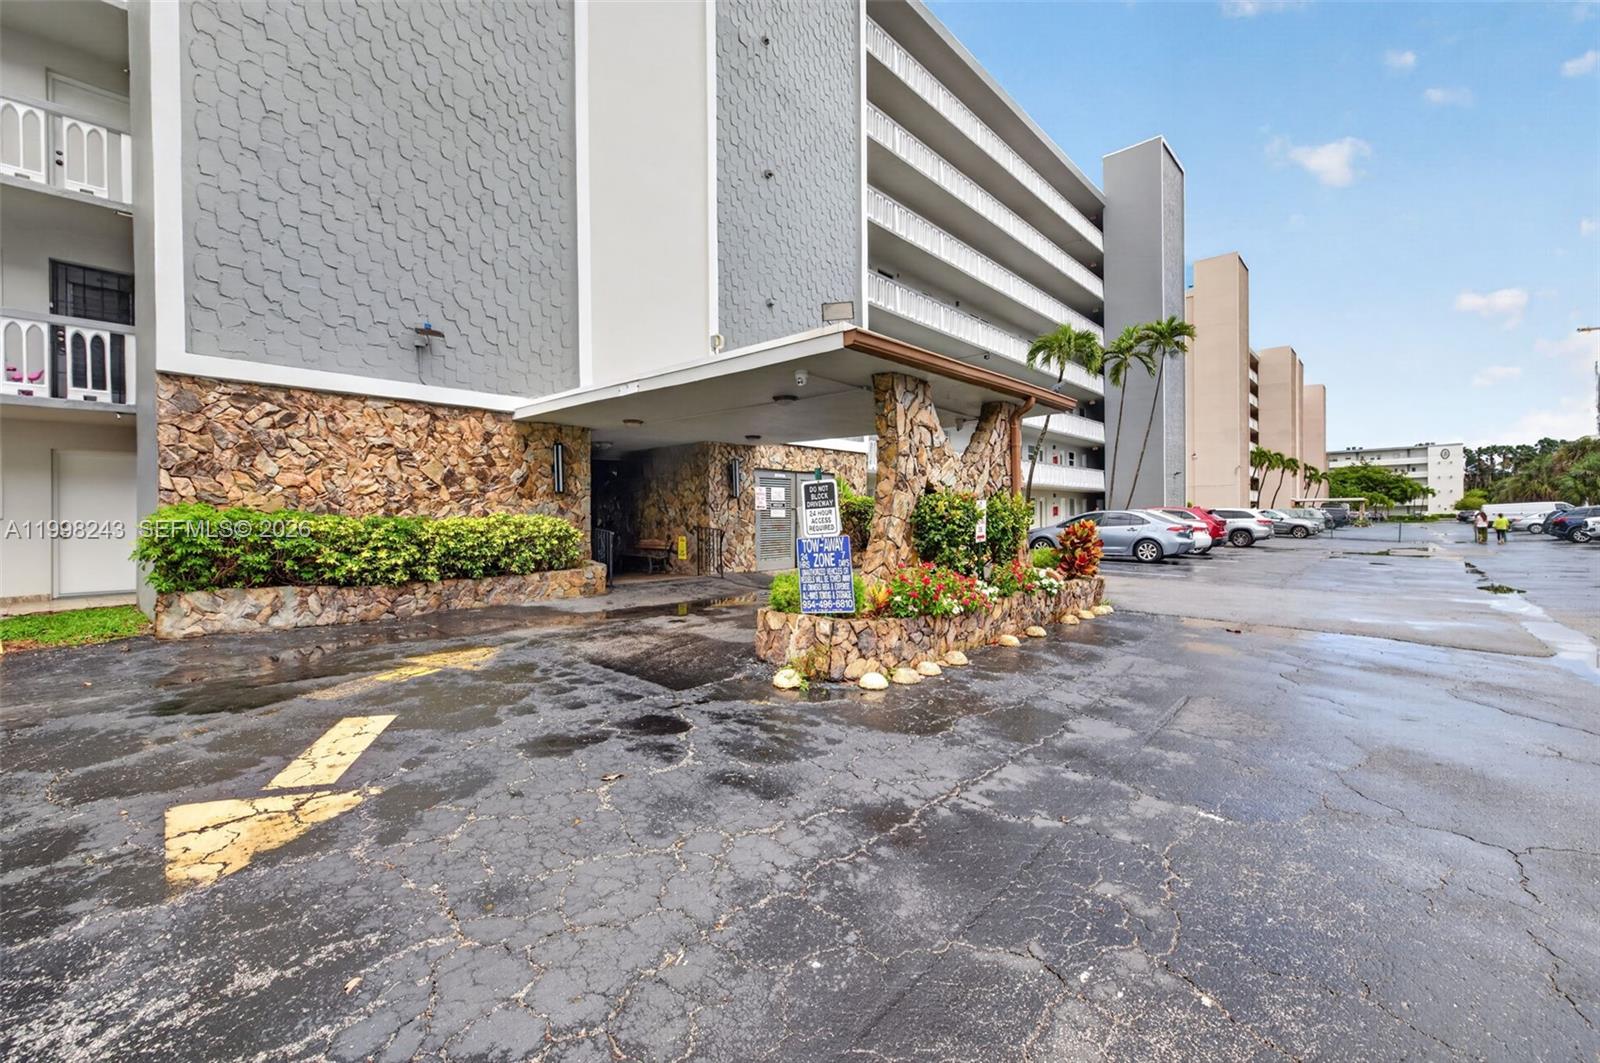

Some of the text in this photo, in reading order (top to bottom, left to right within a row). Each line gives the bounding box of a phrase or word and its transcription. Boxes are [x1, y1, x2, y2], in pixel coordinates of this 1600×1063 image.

[802, 537, 844, 553] TOW-AWAY
[813, 552, 836, 568] ZONE
[840, 551, 846, 559] 7
